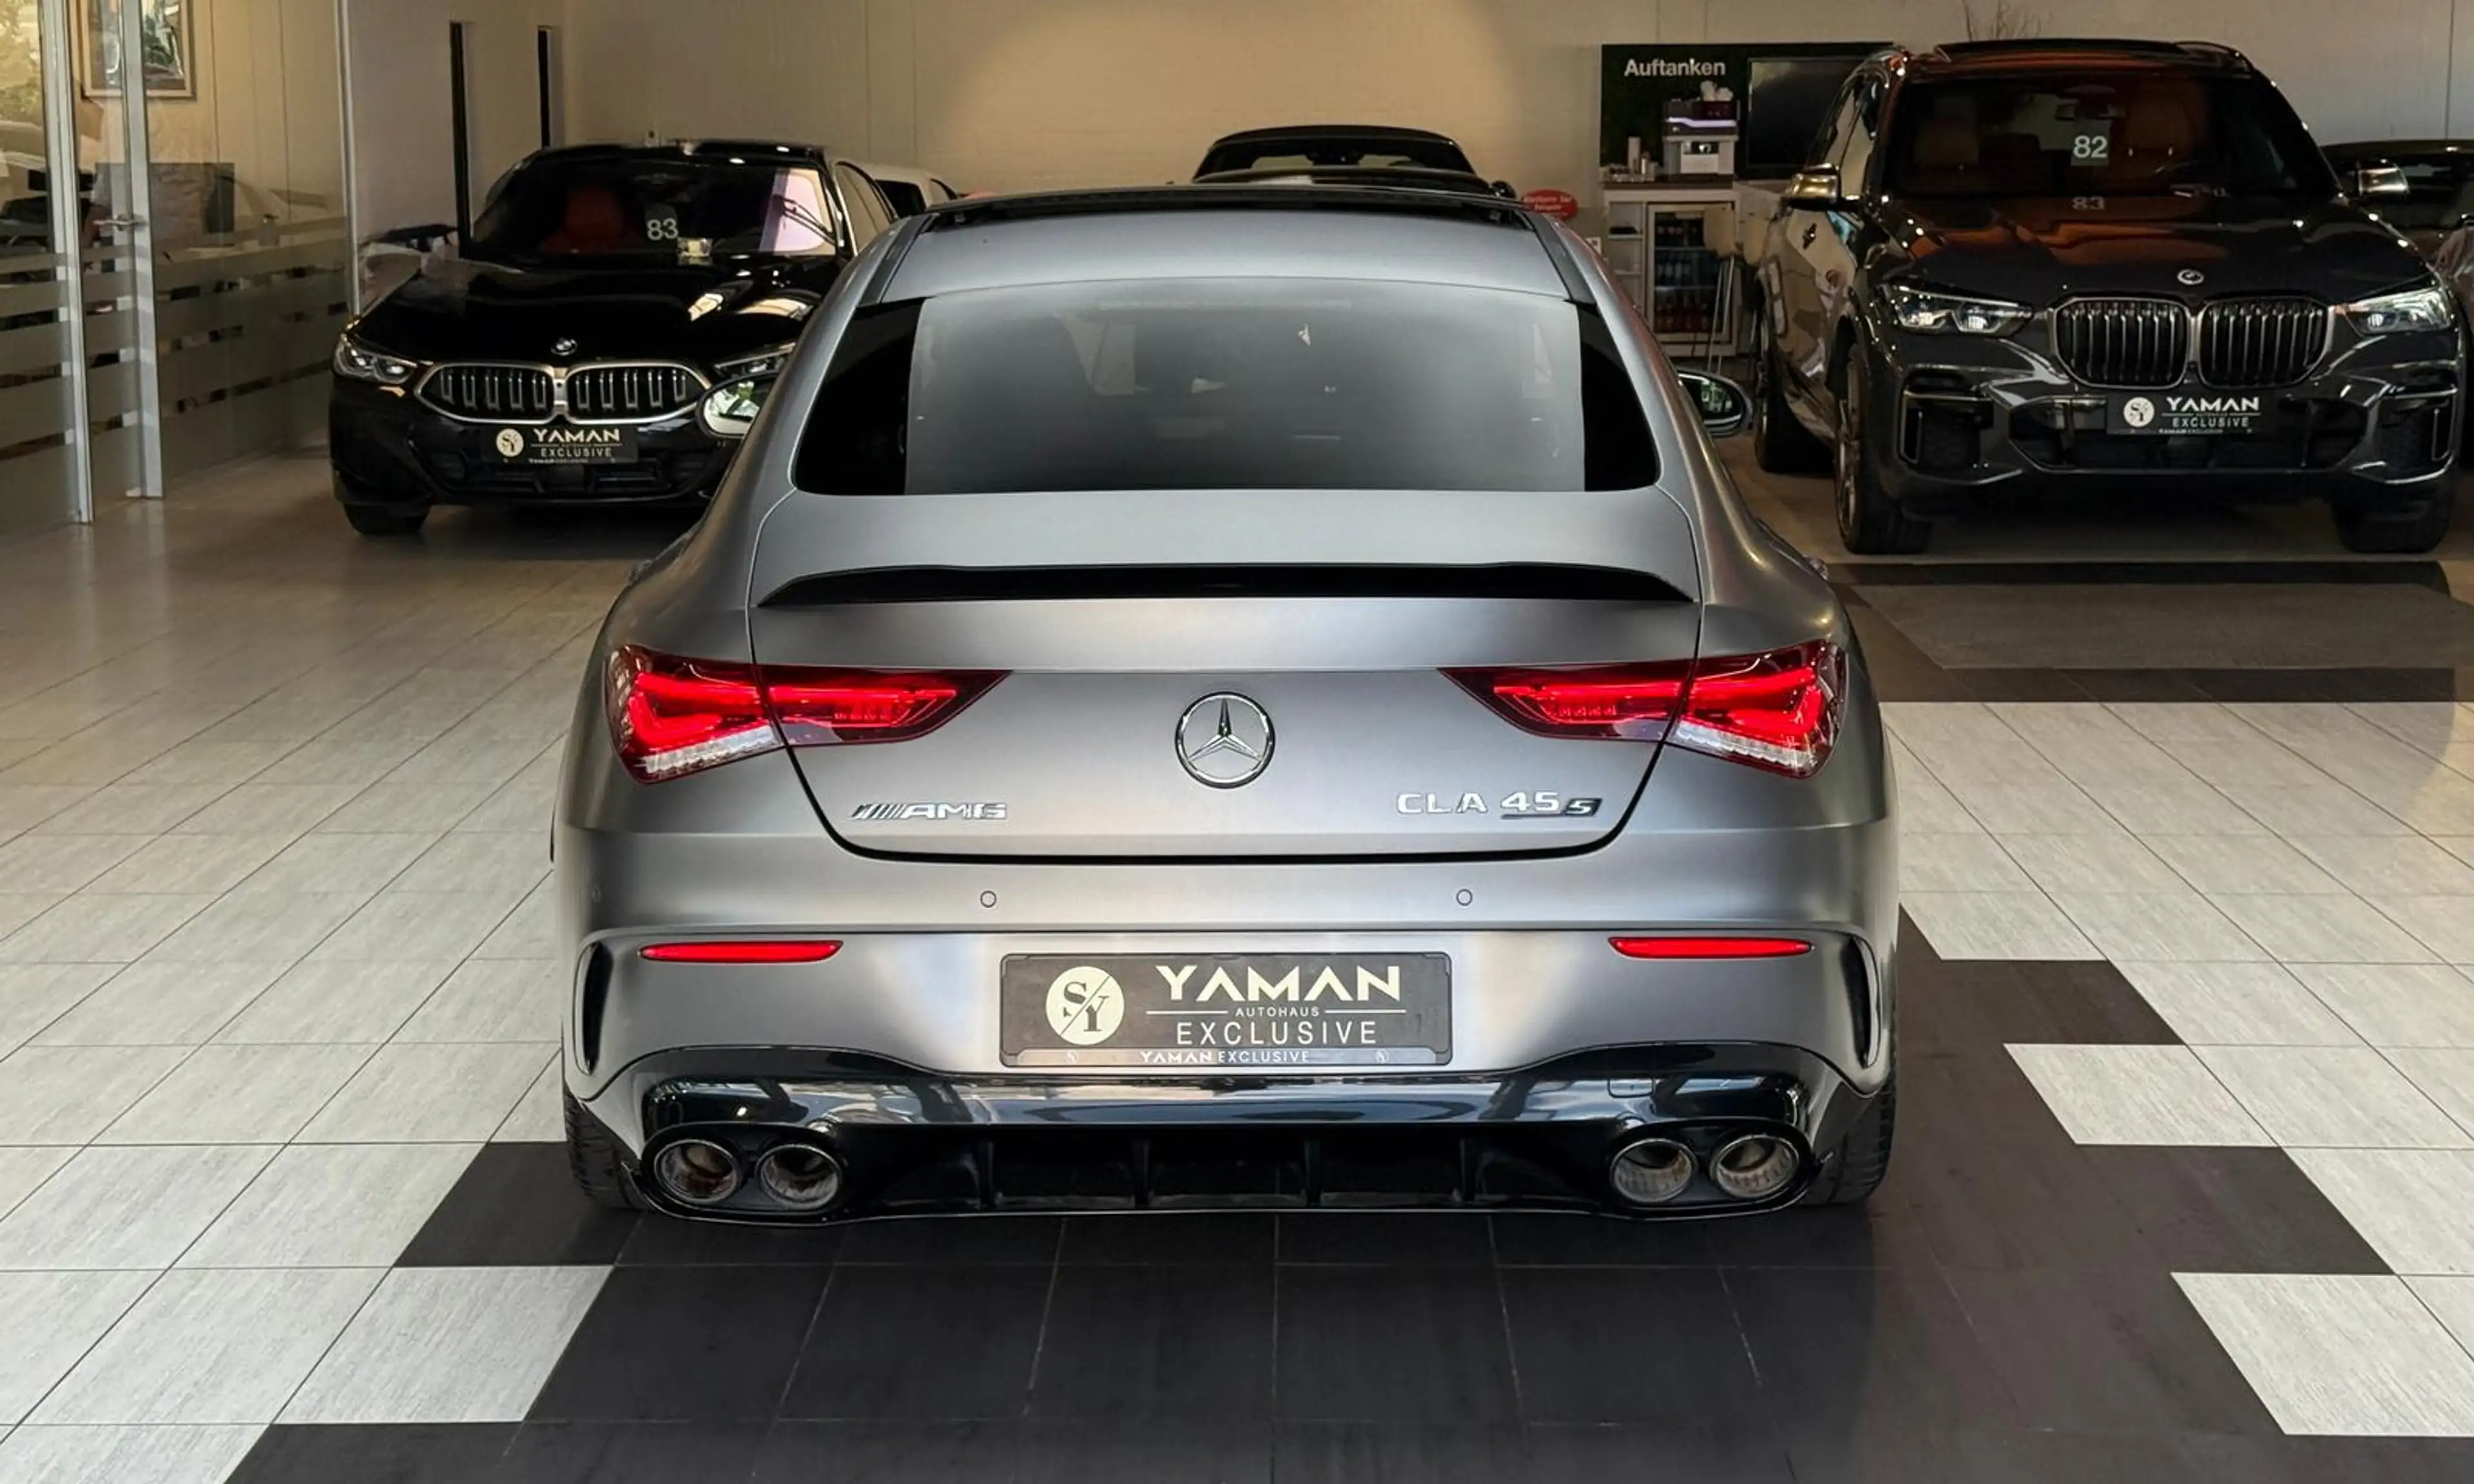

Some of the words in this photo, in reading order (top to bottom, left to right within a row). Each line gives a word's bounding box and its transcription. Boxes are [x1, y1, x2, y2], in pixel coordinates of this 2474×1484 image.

[1624, 57, 1726, 77] Auftanken
[2074, 135, 2108, 158] 82
[647, 218, 678, 241] 83
[2165, 397, 2259, 412] YAMAN
[2172, 417, 2249, 428] EXCLUSIVE
[533, 428, 620, 443] YAMAN
[541, 447, 611, 457] EXCLUSIVE
[1397, 793, 1488, 814] CLA
[1500, 792, 1560, 812] 45
[1155, 966, 1400, 1002] YAMAN
[1235, 1007, 1319, 1018] AUTOHAUS
[1177, 1021, 1376, 1045] EXCLUSIVE
[1140, 1051, 1212, 1063] YAMAN
[1218, 1051, 1309, 1063] EXCLUSIVE
